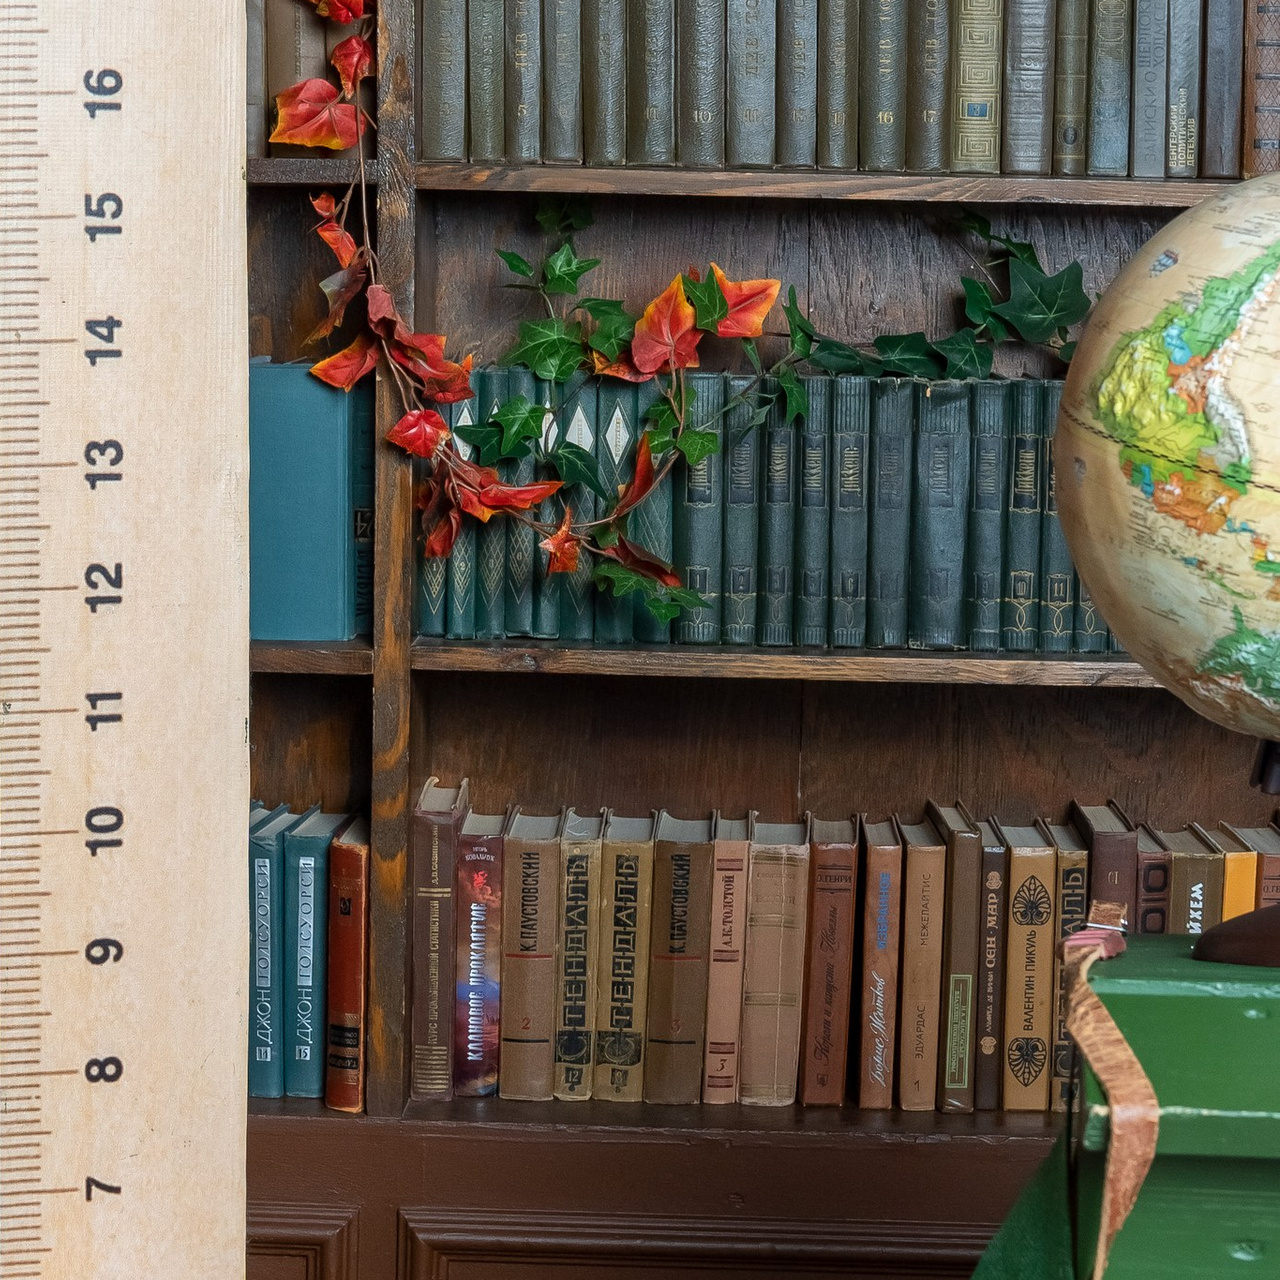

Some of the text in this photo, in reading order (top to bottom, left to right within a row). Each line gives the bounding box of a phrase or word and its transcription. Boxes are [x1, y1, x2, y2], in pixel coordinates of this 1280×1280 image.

[84, 69, 123, 119] 16
[1178, 88, 1187, 167] ПОЛИТИЧЕСКИЙ
[1186, 118, 1195, 167] ДЕТЕКТИВ
[84, 192, 123, 243] 15
[85, 316, 122, 366] 14
[84, 439, 124, 490] 13
[84, 563, 123, 614] 12
[459, 561, 466, 571] 2
[1053, 583, 1065, 597] 11
[85, 692, 123, 732] 11
[85, 806, 124, 857] 10
[84, 938, 124, 966] 9
[256, 862, 274, 1045] ДЖОН ГОЛСУОРСИ
[297, 861, 313, 1044] ДЖОН ГОЛСУОРСИ
[556, 855, 589, 1063] СТЕНДАЛЬ
[597, 855, 641, 1066] СТЕНДАЛЬ
[915, 872, 931, 1059] ЭДУАРДАС МЕЖЕЛАЙТИС
[1023, 929, 1037, 1031] ВАЛЕНТИН ПИКУЛЬ
[84, 1056, 123, 1083] 8
[85, 1176, 122, 1202] 7
